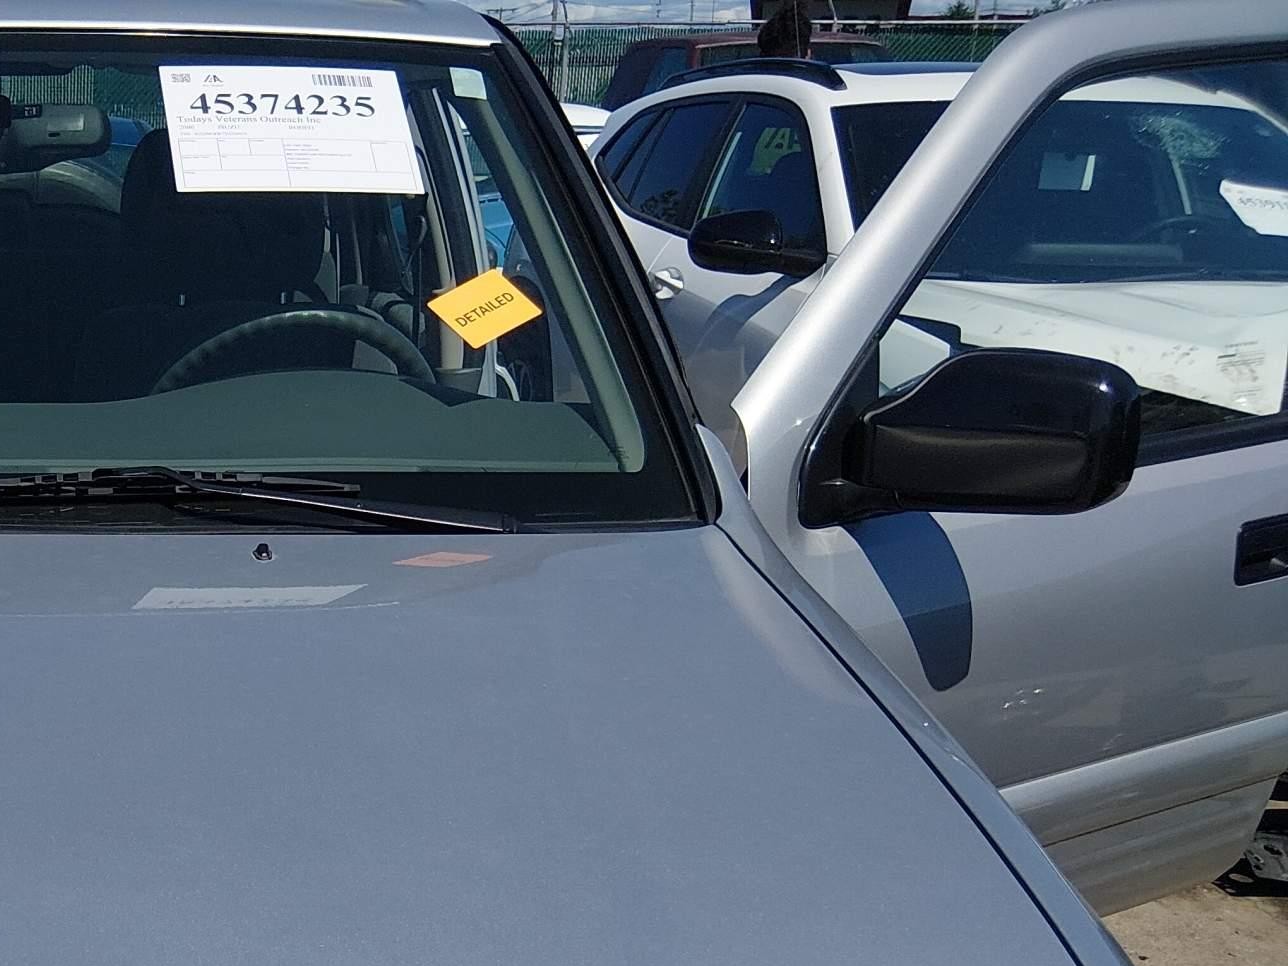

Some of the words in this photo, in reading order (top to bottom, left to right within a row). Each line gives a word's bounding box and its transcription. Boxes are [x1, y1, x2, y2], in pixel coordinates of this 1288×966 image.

[189, 92, 376, 118] 45374235
[176, 115, 213, 125] Todays
[215, 115, 258, 124] Veterans
[259, 115, 304, 124] Outreach
[454, 292, 515, 328] DETAILED
